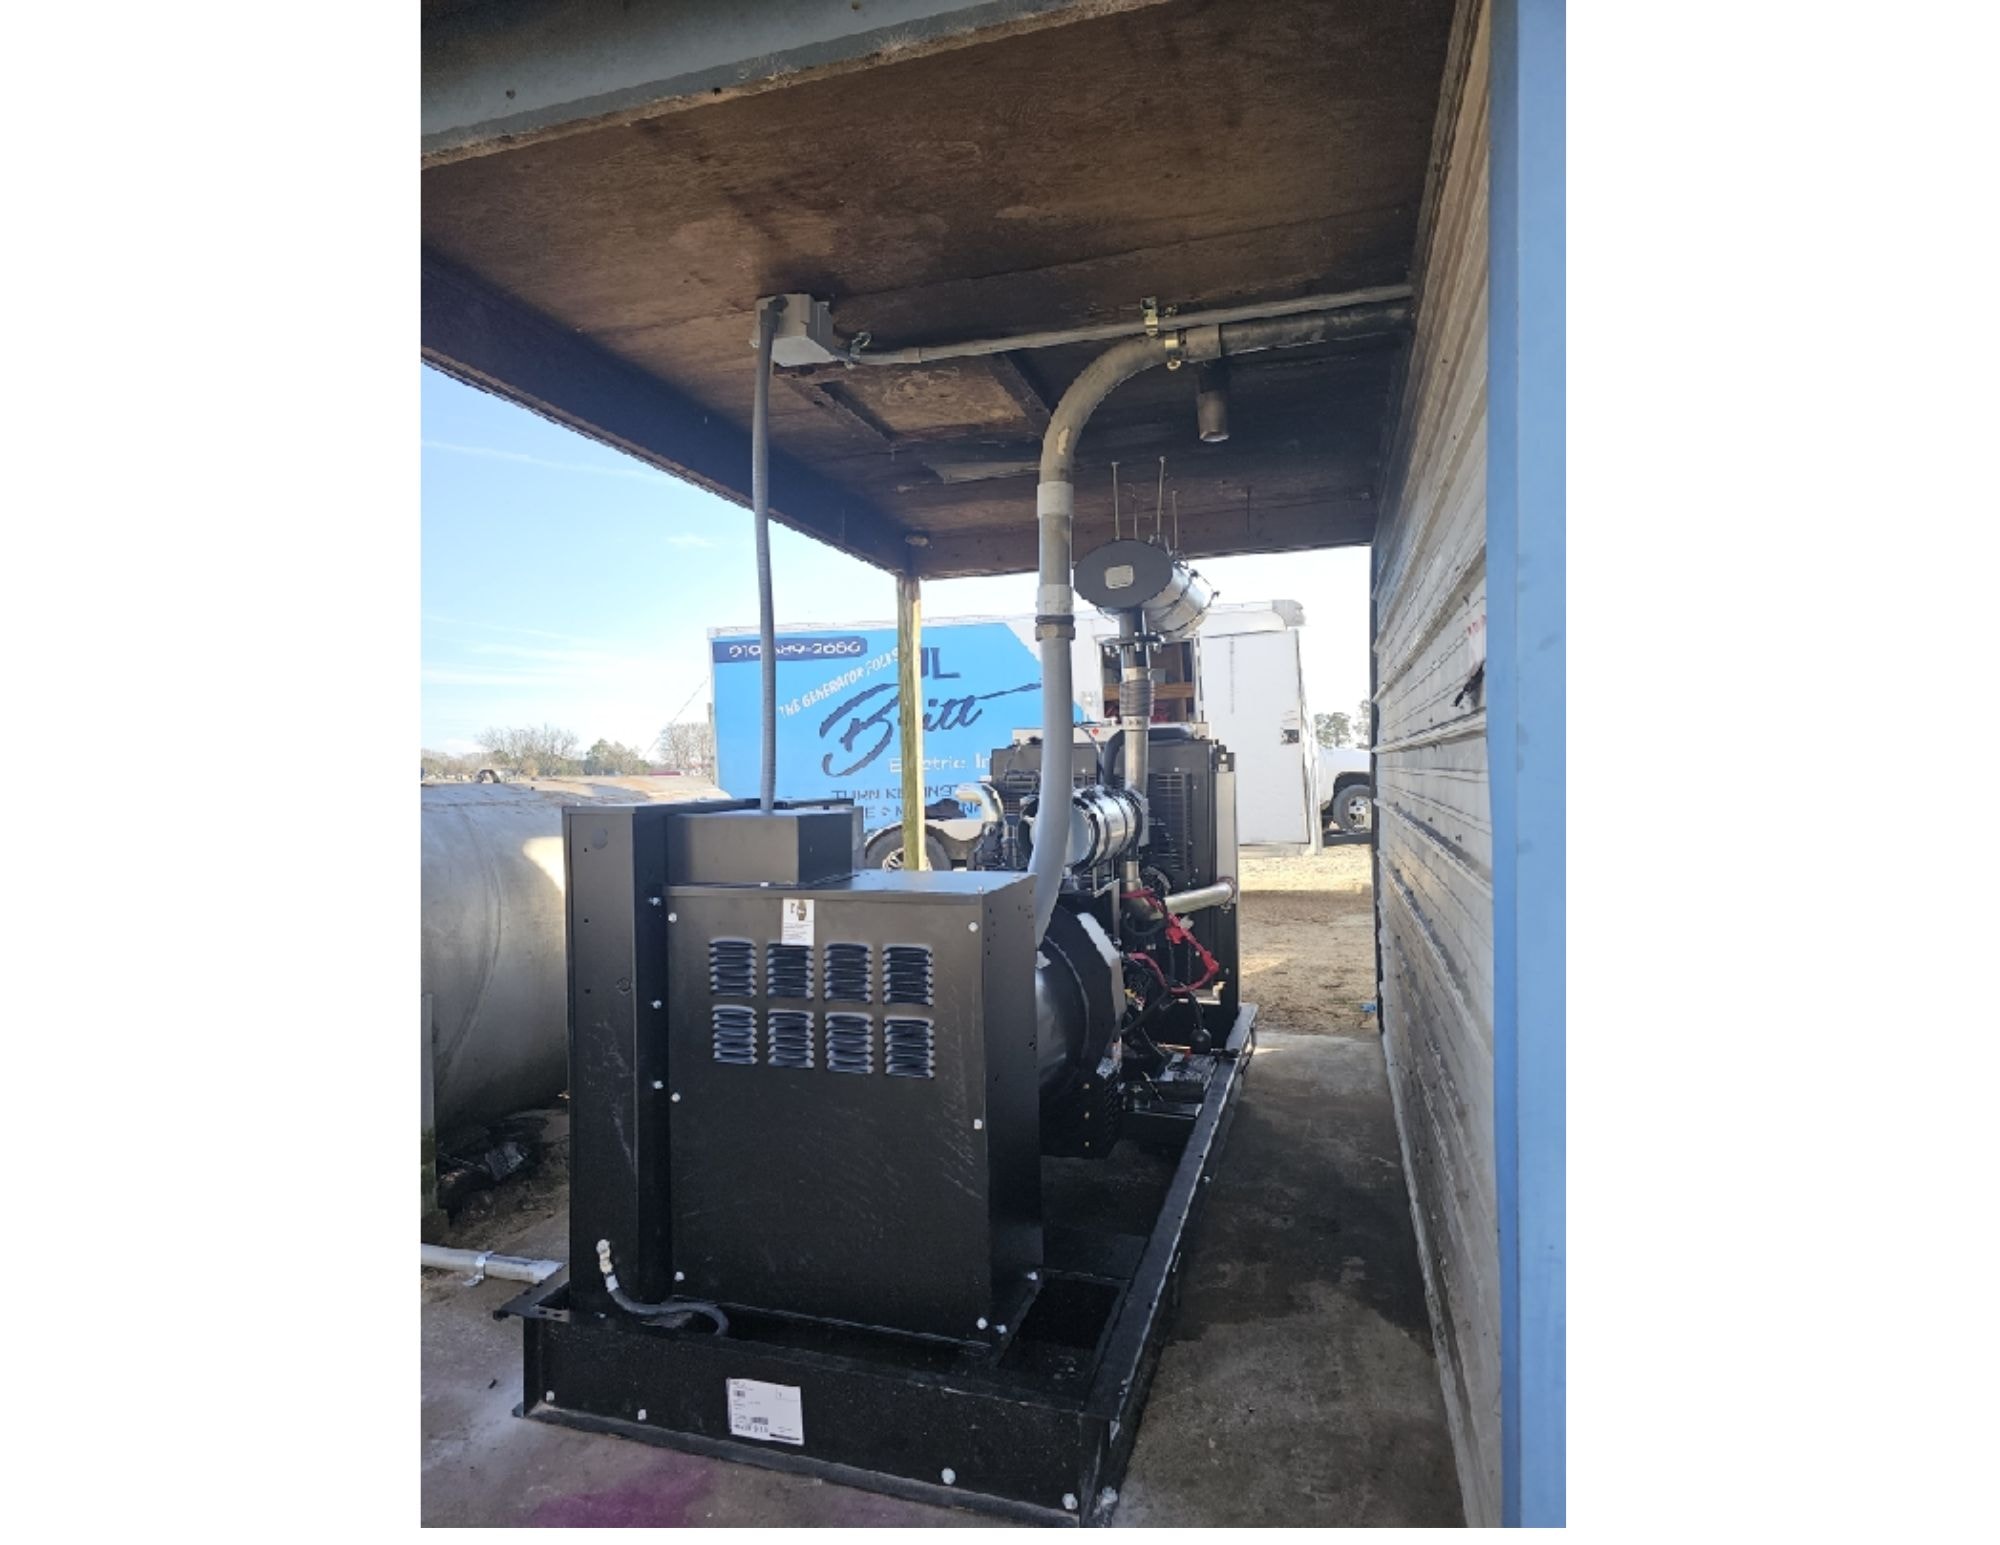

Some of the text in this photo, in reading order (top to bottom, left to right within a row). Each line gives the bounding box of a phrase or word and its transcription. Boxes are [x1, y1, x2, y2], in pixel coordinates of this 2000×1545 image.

[778, 697, 802, 719] THE
[801, 666, 865, 708] GENERATOR
[819, 682, 1042, 777] Bitt
[889, 752, 991, 773] Ectric In
